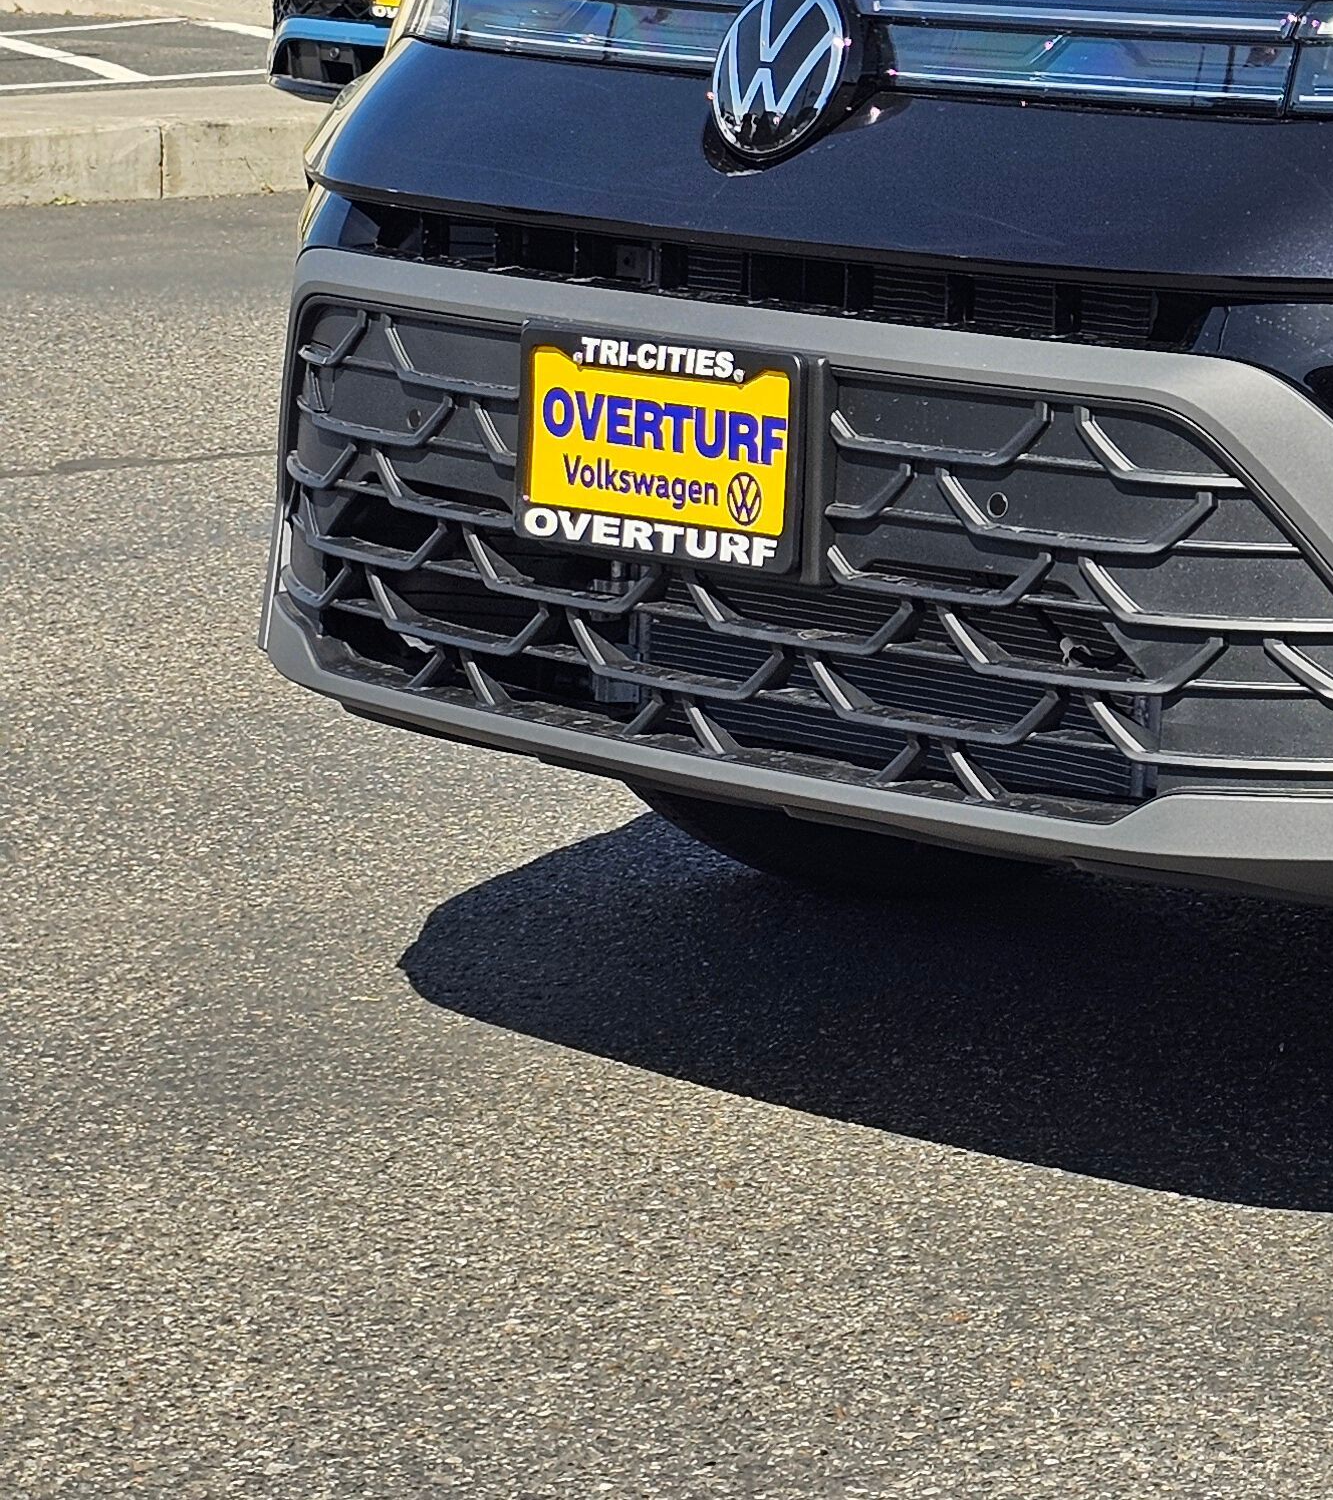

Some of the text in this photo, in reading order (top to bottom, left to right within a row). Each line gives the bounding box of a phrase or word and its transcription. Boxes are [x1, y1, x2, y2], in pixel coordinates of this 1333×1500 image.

[580, 336, 735, 380] TRI-CITIES
[542, 386, 788, 466] OVERTURF
[562, 453, 719, 510] Volkswagen
[523, 507, 778, 568] OVERTURF
